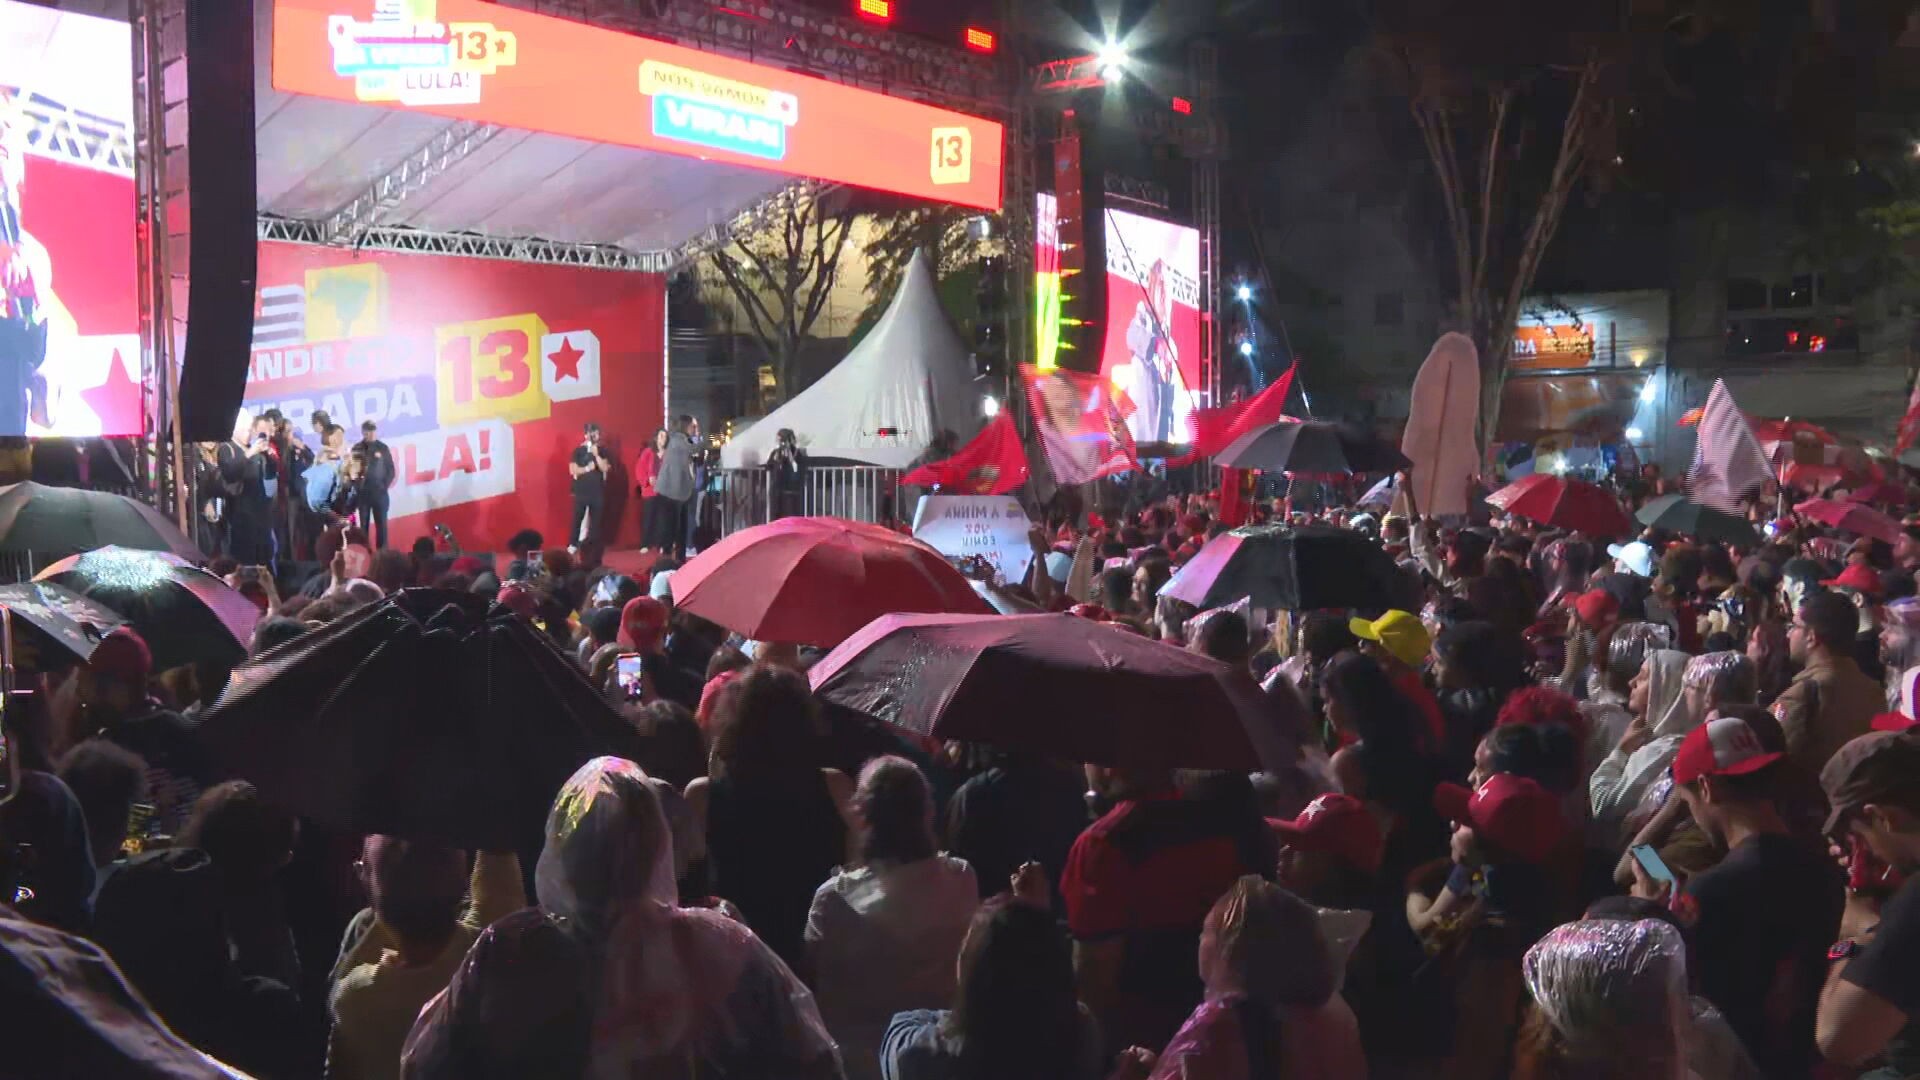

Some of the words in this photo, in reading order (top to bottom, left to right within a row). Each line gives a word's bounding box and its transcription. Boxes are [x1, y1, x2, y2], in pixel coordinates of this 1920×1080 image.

[453, 31, 488, 60] 13
[406, 72, 470, 90] LULA!
[934, 135, 964, 168] 13
[443, 331, 530, 403] 13
